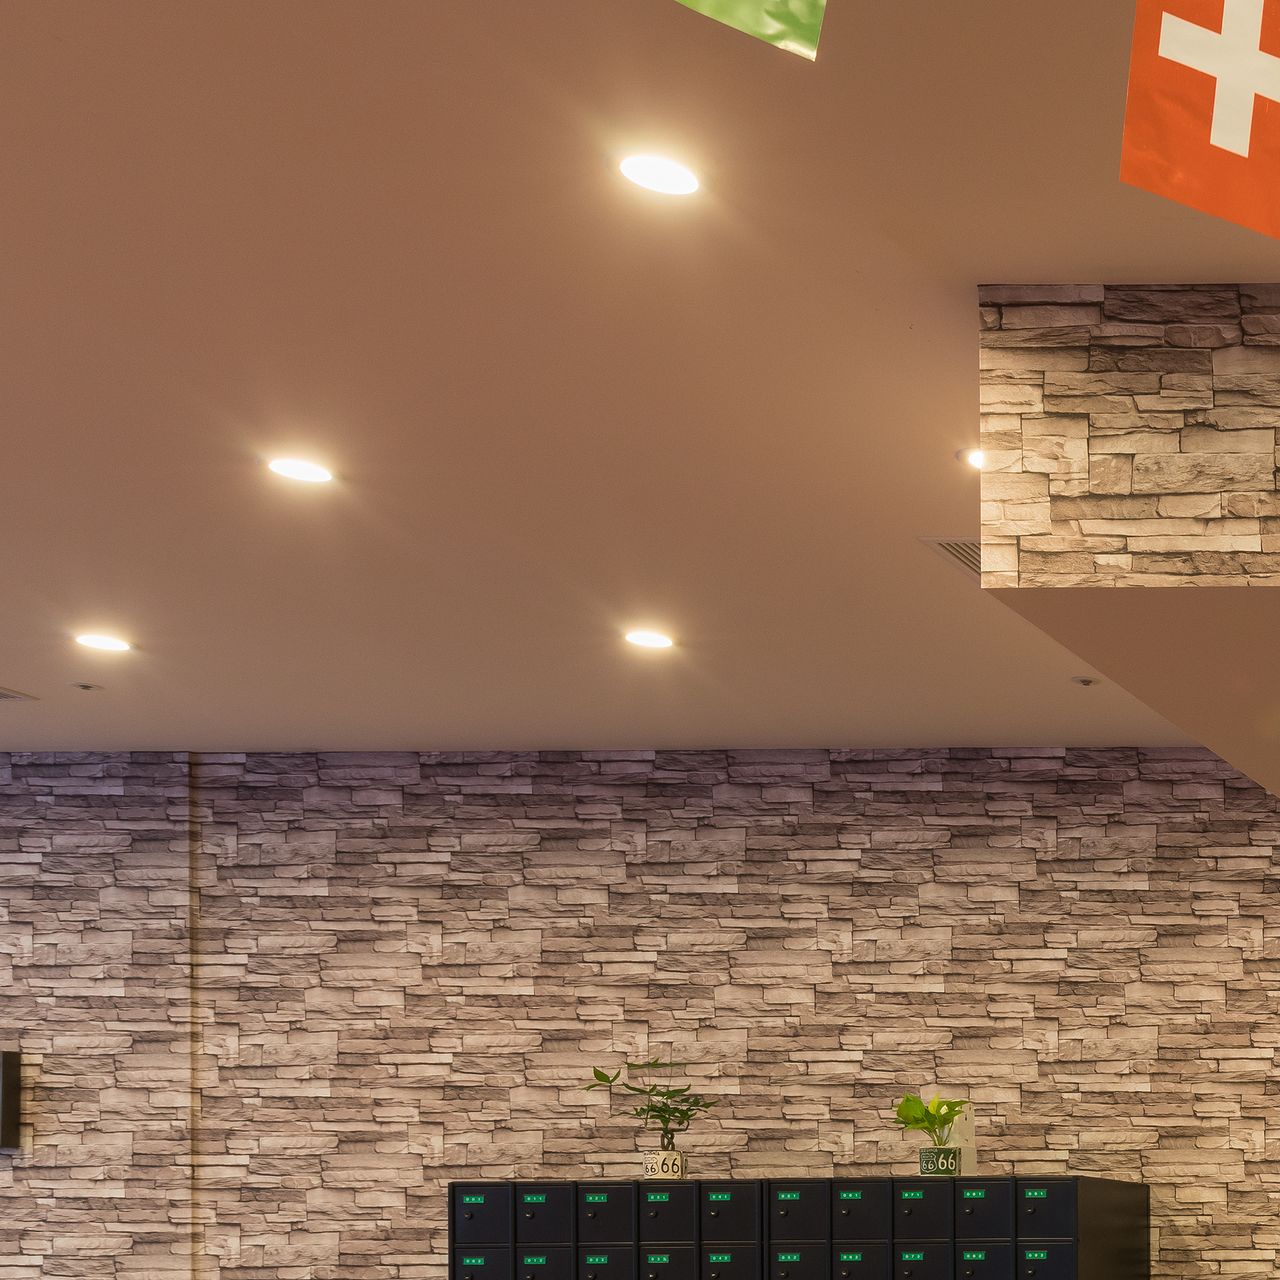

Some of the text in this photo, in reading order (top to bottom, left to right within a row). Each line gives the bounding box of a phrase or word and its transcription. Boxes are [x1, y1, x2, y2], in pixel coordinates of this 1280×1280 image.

[645, 1157, 680, 1174] 66 66
[922, 1153, 956, 1170] 66 66
